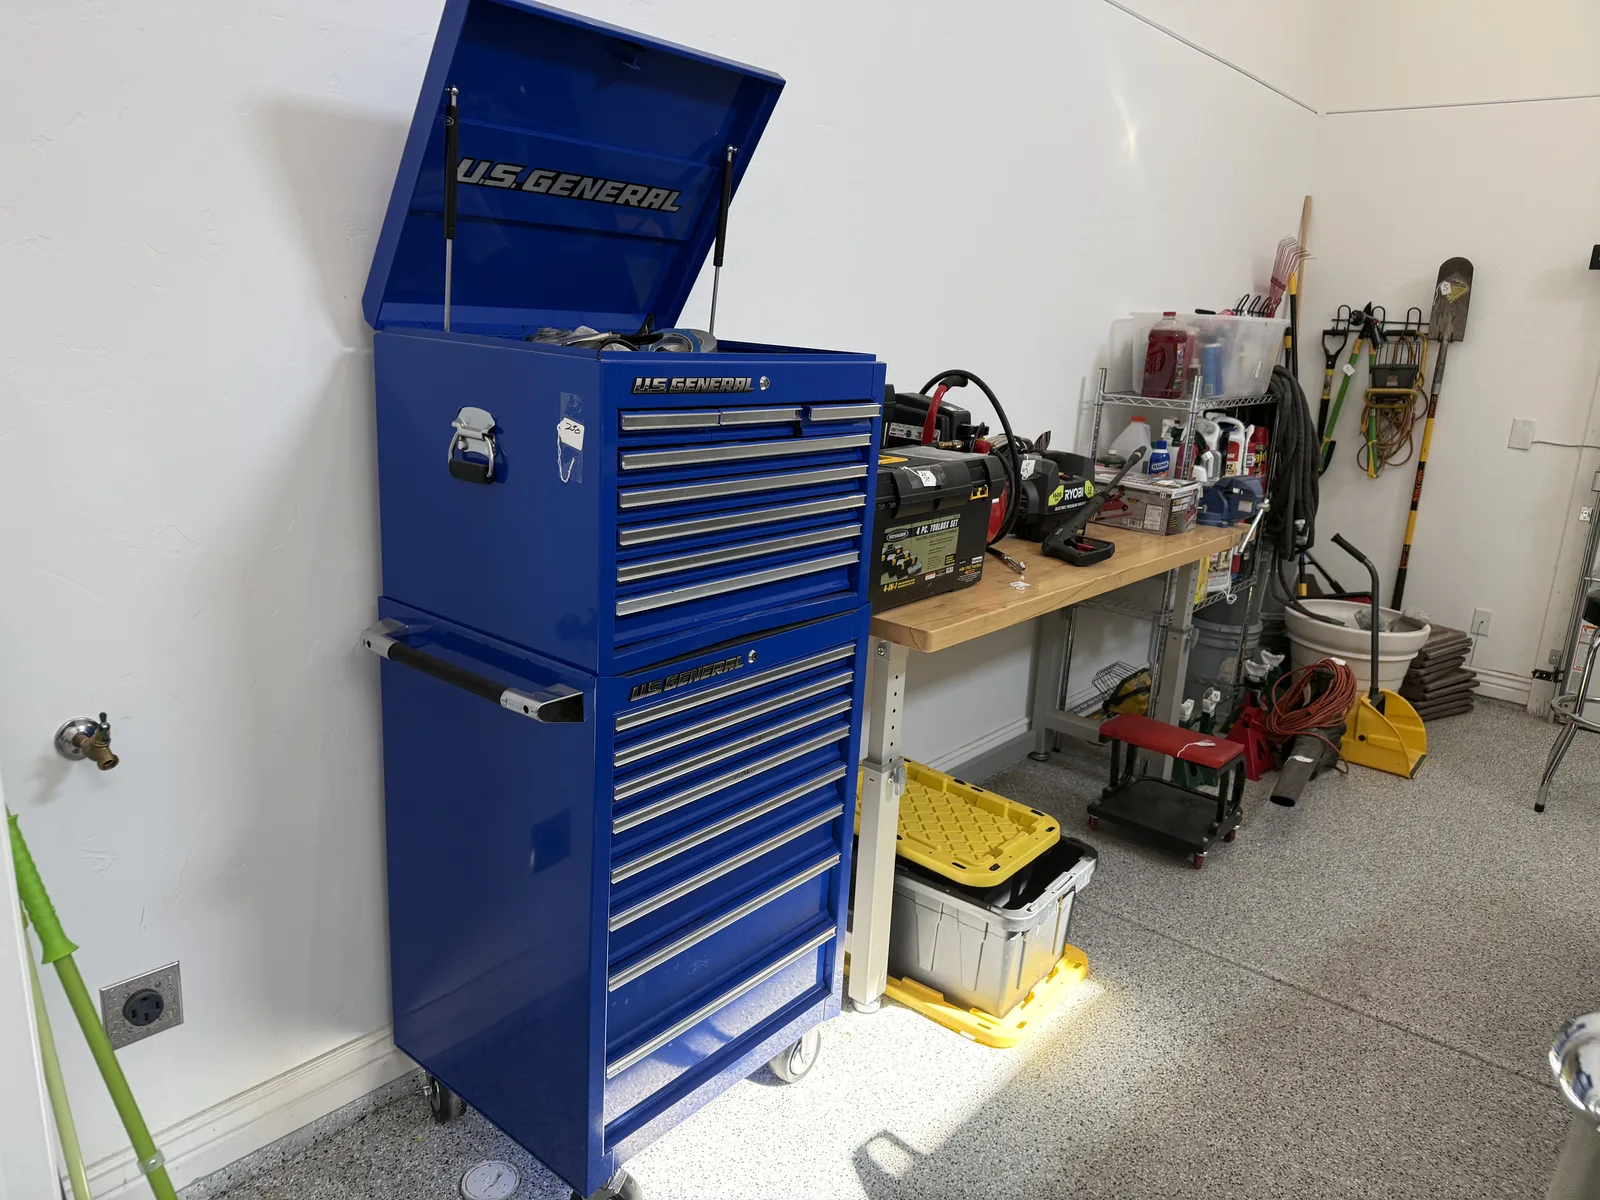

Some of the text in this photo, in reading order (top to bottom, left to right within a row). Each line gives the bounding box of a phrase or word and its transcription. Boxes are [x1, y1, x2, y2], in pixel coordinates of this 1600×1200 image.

[457, 157, 683, 213] U.S. GENERAL
[632, 377, 754, 394] U.S. GENERAL
[564, 422, 581, 435] 250
[1065, 486, 1084, 500] RYOBI
[915, 526, 921, 536] 4
[929, 520, 950, 533] TOOLBOX
[950, 519, 959, 528] SET
[664, 656, 744, 691] GENERAL
